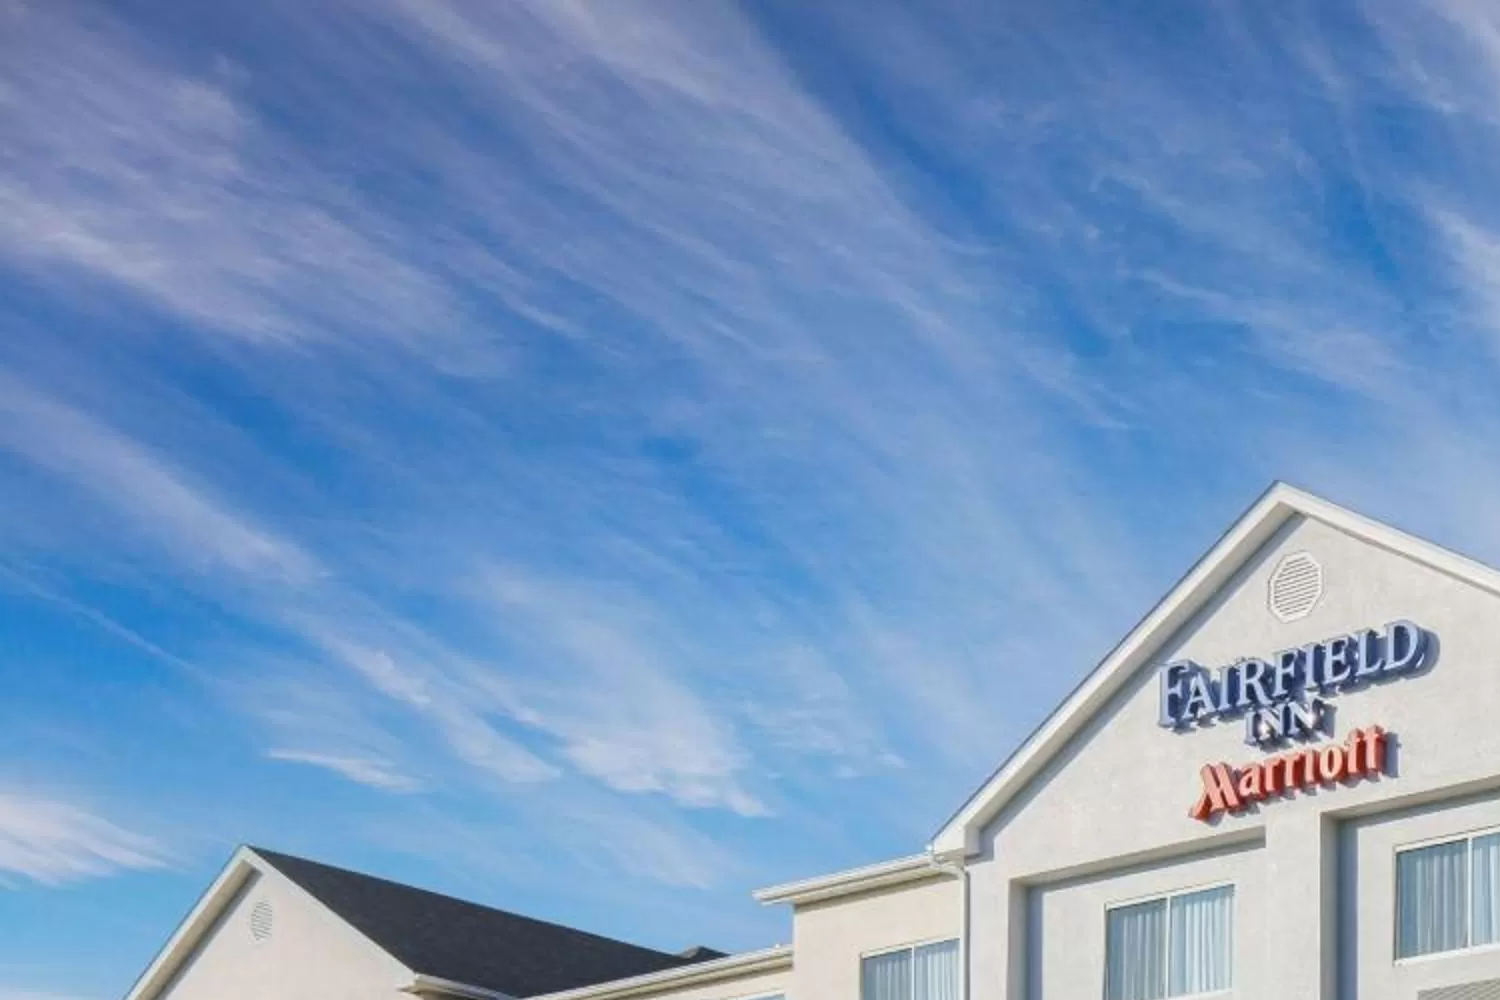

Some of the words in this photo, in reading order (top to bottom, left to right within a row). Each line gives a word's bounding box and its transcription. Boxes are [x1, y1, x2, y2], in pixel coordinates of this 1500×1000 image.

[1158, 619, 1432, 730] FAIRFIELD
[1243, 698, 1324, 746] INN
[1187, 724, 1389, 822] Marriott
